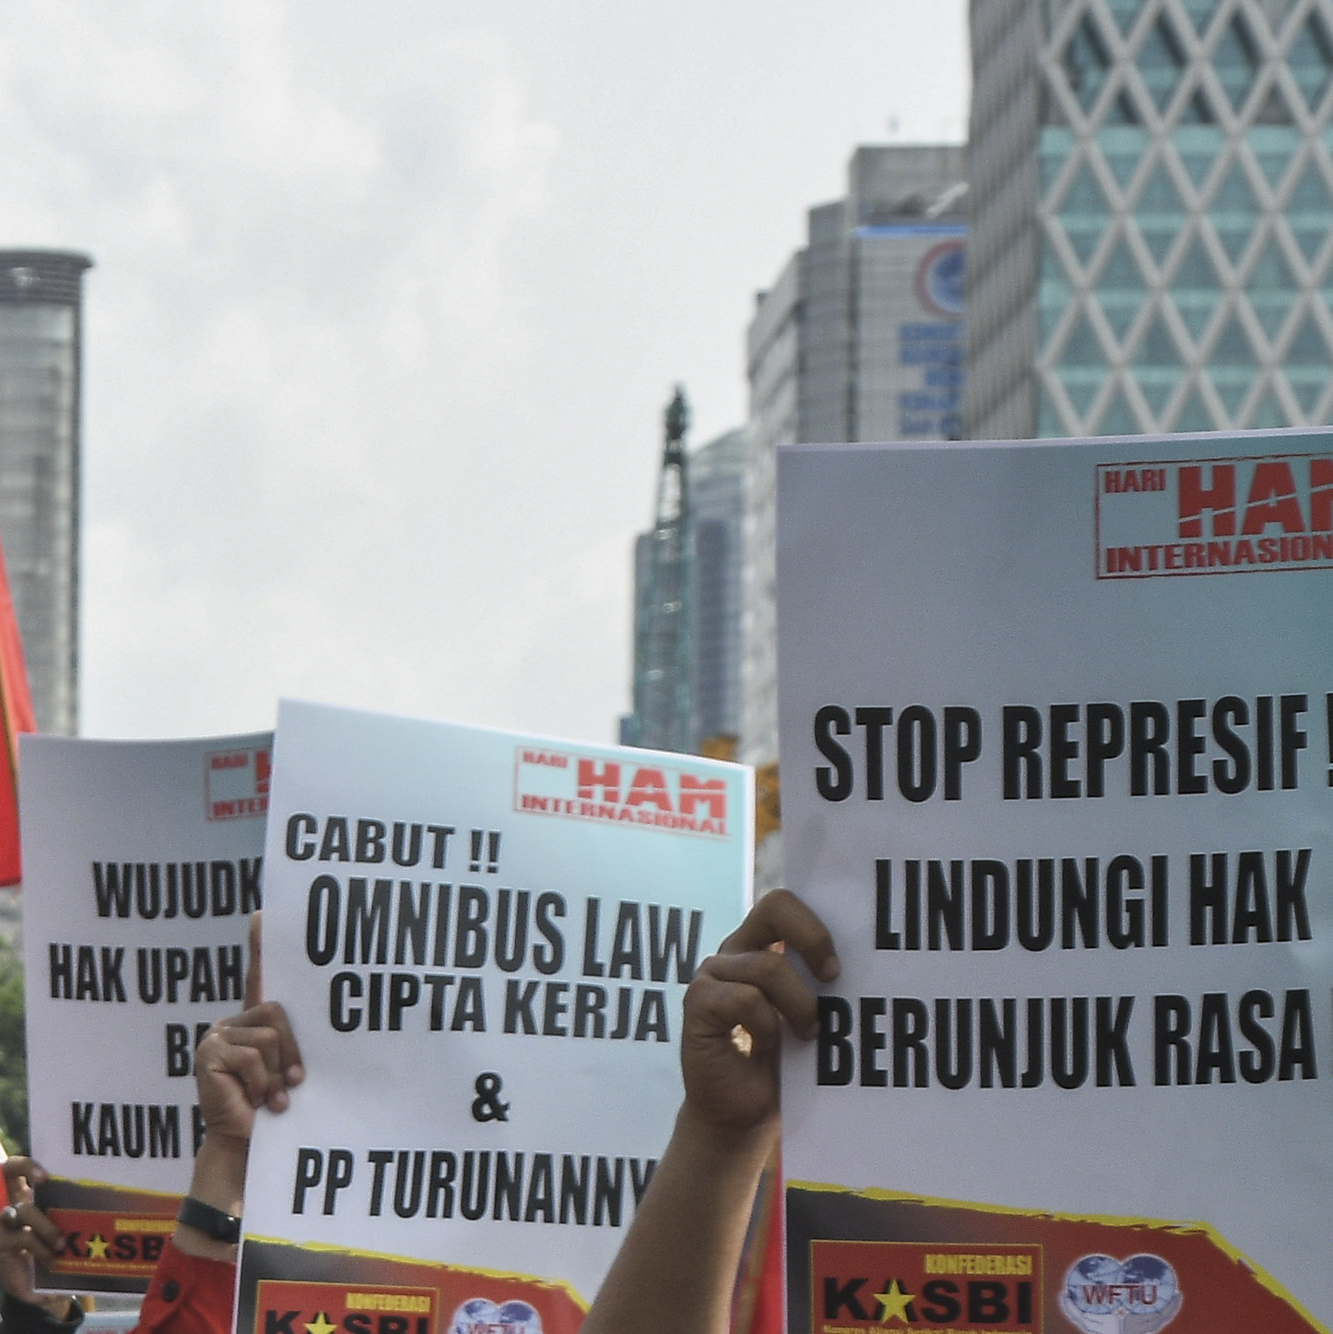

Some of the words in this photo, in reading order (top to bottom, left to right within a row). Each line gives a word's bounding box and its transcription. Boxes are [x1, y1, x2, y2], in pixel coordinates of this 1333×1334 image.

[1104, 469, 1165, 494] HARI
[813, 704, 983, 803] STOP
[1001, 694, 1309, 801] REPRESIF
[522, 791, 726, 833] INTERNASIONAL
[524, 753, 567, 766] HARI
[577, 759, 726, 821] HAM
[285, 814, 455, 869] CABUT
[469, 830, 500, 874] !!
[306, 875, 565, 975] OMNIBUS
[582, 896, 703, 984] LAW
[874, 854, 1169, 953] LINDUNGI
[1188, 848, 1313, 947] HAK
[49, 943, 128, 1003] HAK
[137, 945, 242, 1004] UPAH
[329, 971, 486, 1033] CIPTA
[503, 979, 669, 1043] KERJA
[817, 995, 1136, 1091] BERUNJUK
[1153, 988, 1319, 1087] RASA
[471, 1072, 509, 1123] &
[71, 1101, 181, 1159] KAUM
[292, 1148, 353, 1216] PP
[925, 1254, 1032, 1275] KONFEDERASI
[1083, 1284, 1158, 1305] WFTU
